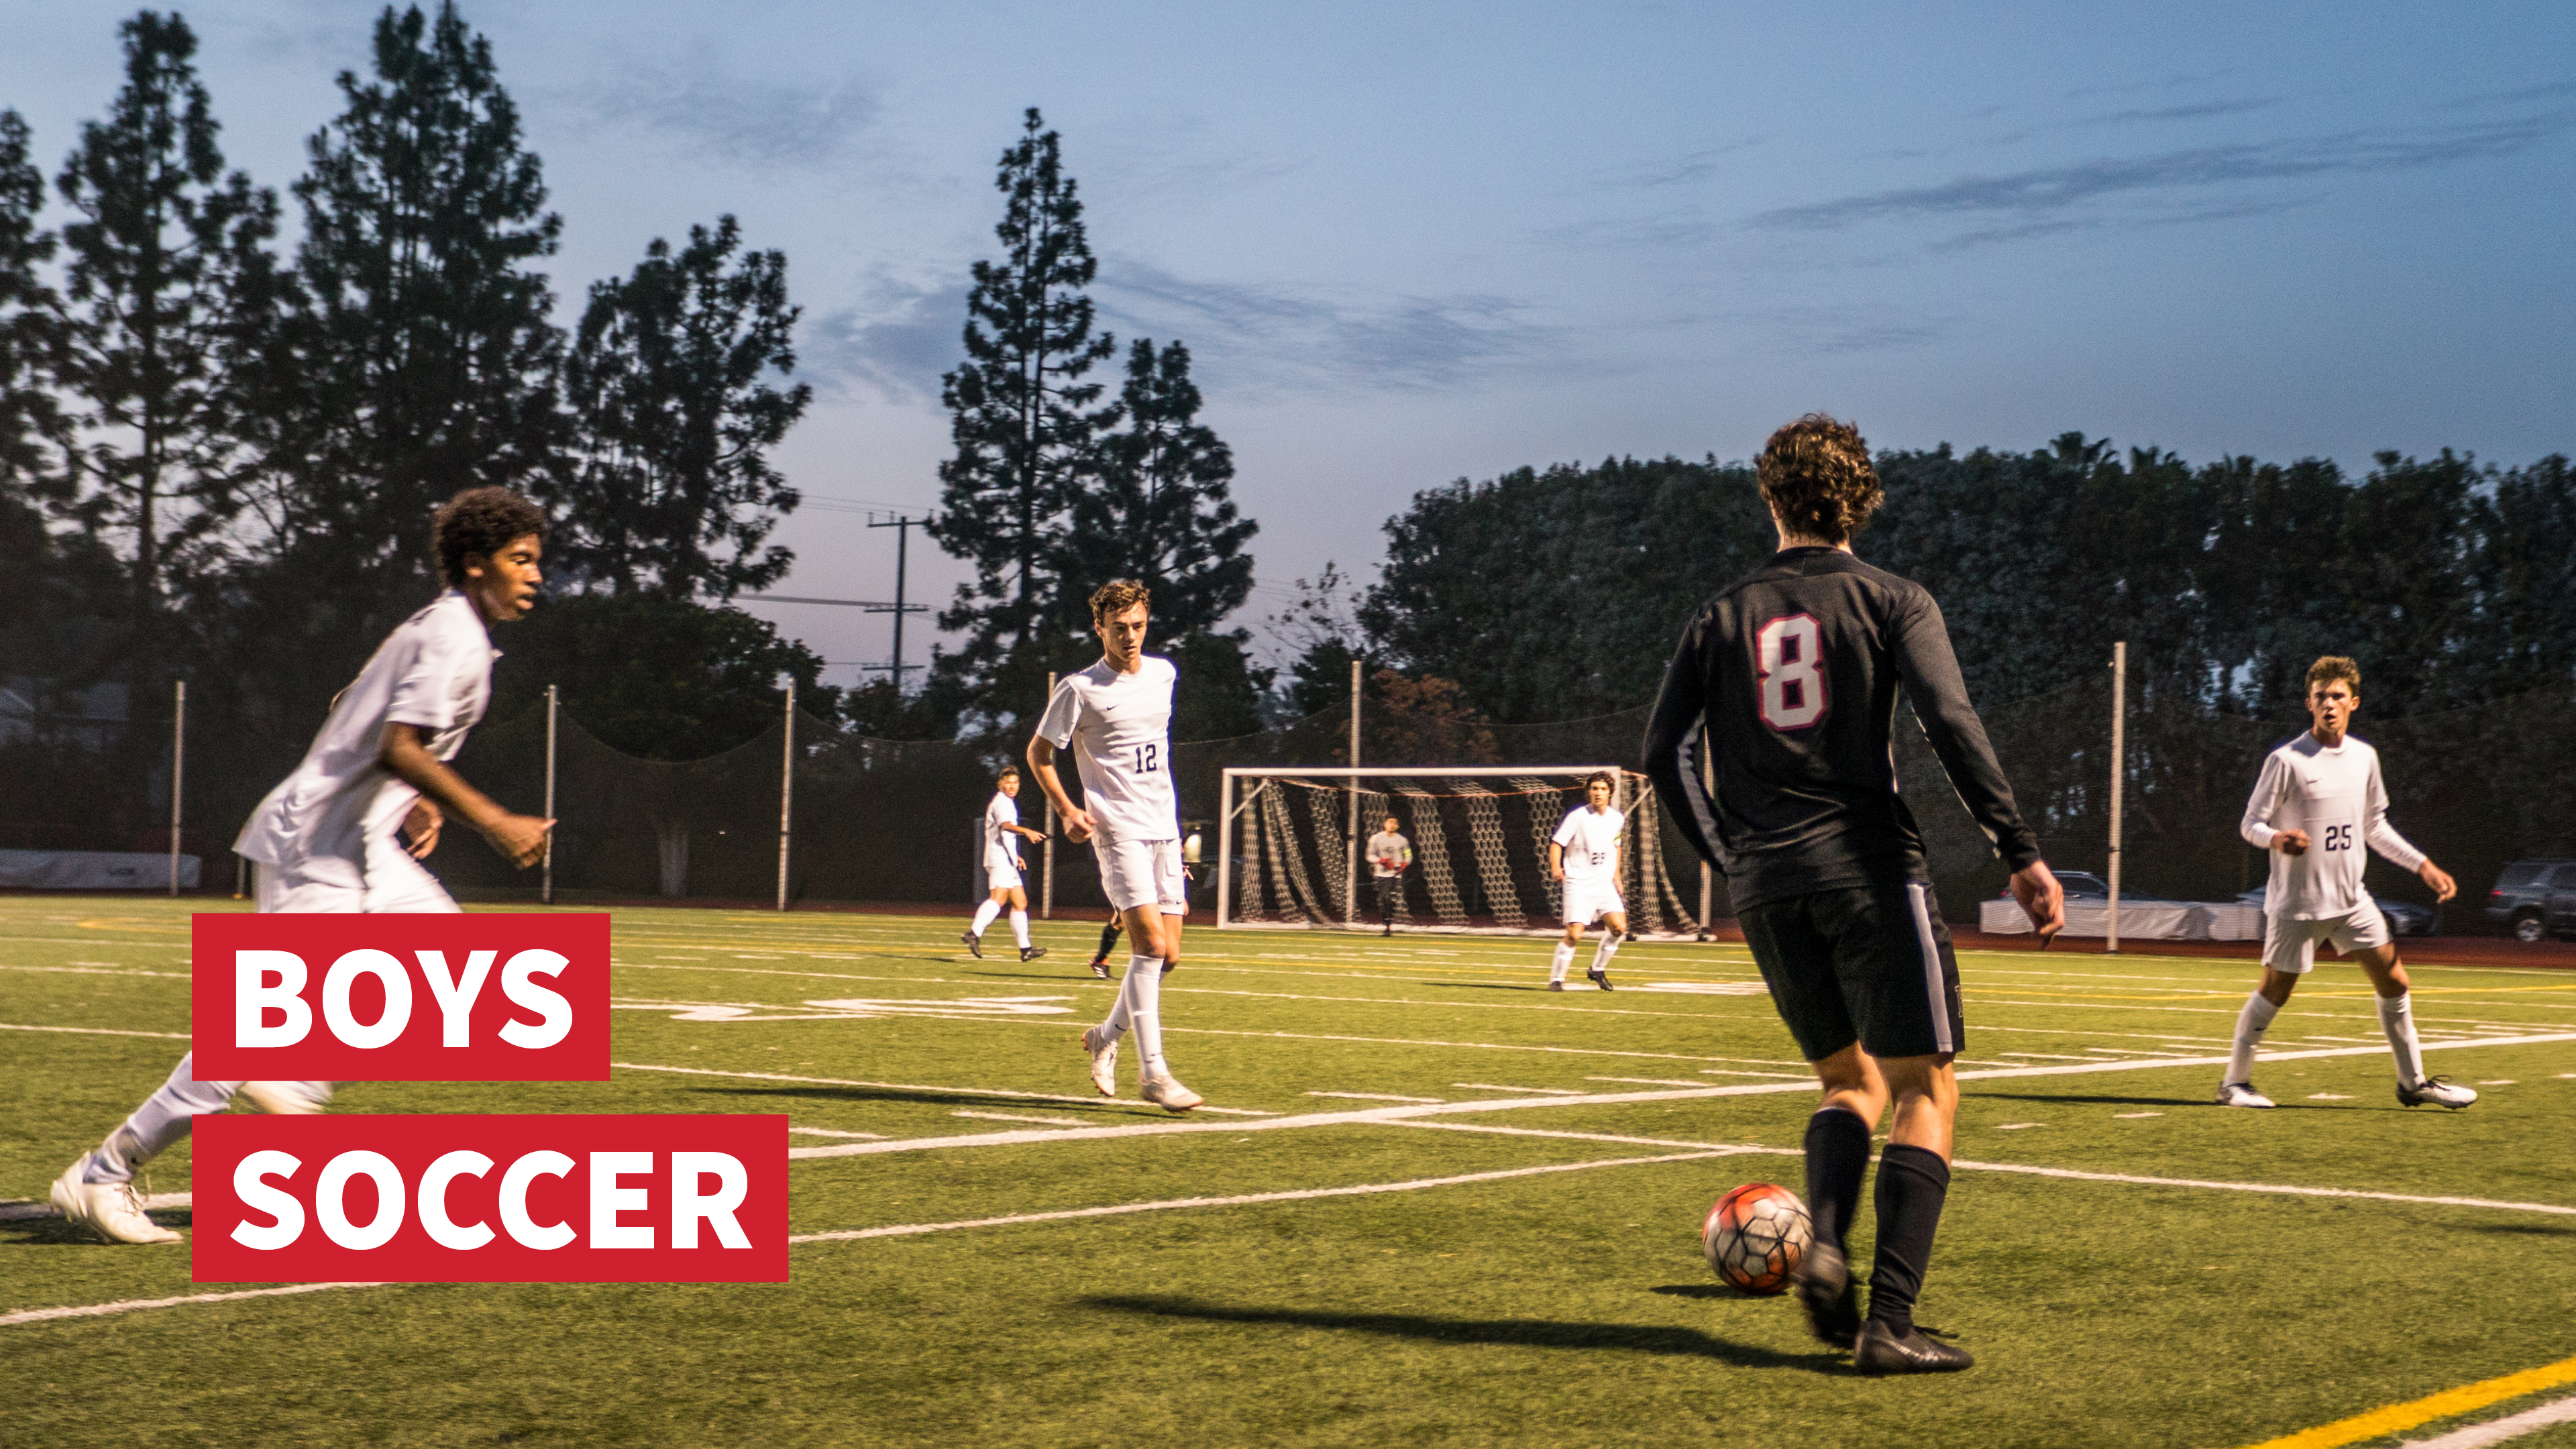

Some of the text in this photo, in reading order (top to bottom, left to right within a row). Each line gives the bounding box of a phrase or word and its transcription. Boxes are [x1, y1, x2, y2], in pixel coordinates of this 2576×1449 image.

[1756, 612, 1827, 731] 8
[1135, 744, 1157, 773] 12
[2325, 824, 2352, 851] 25
